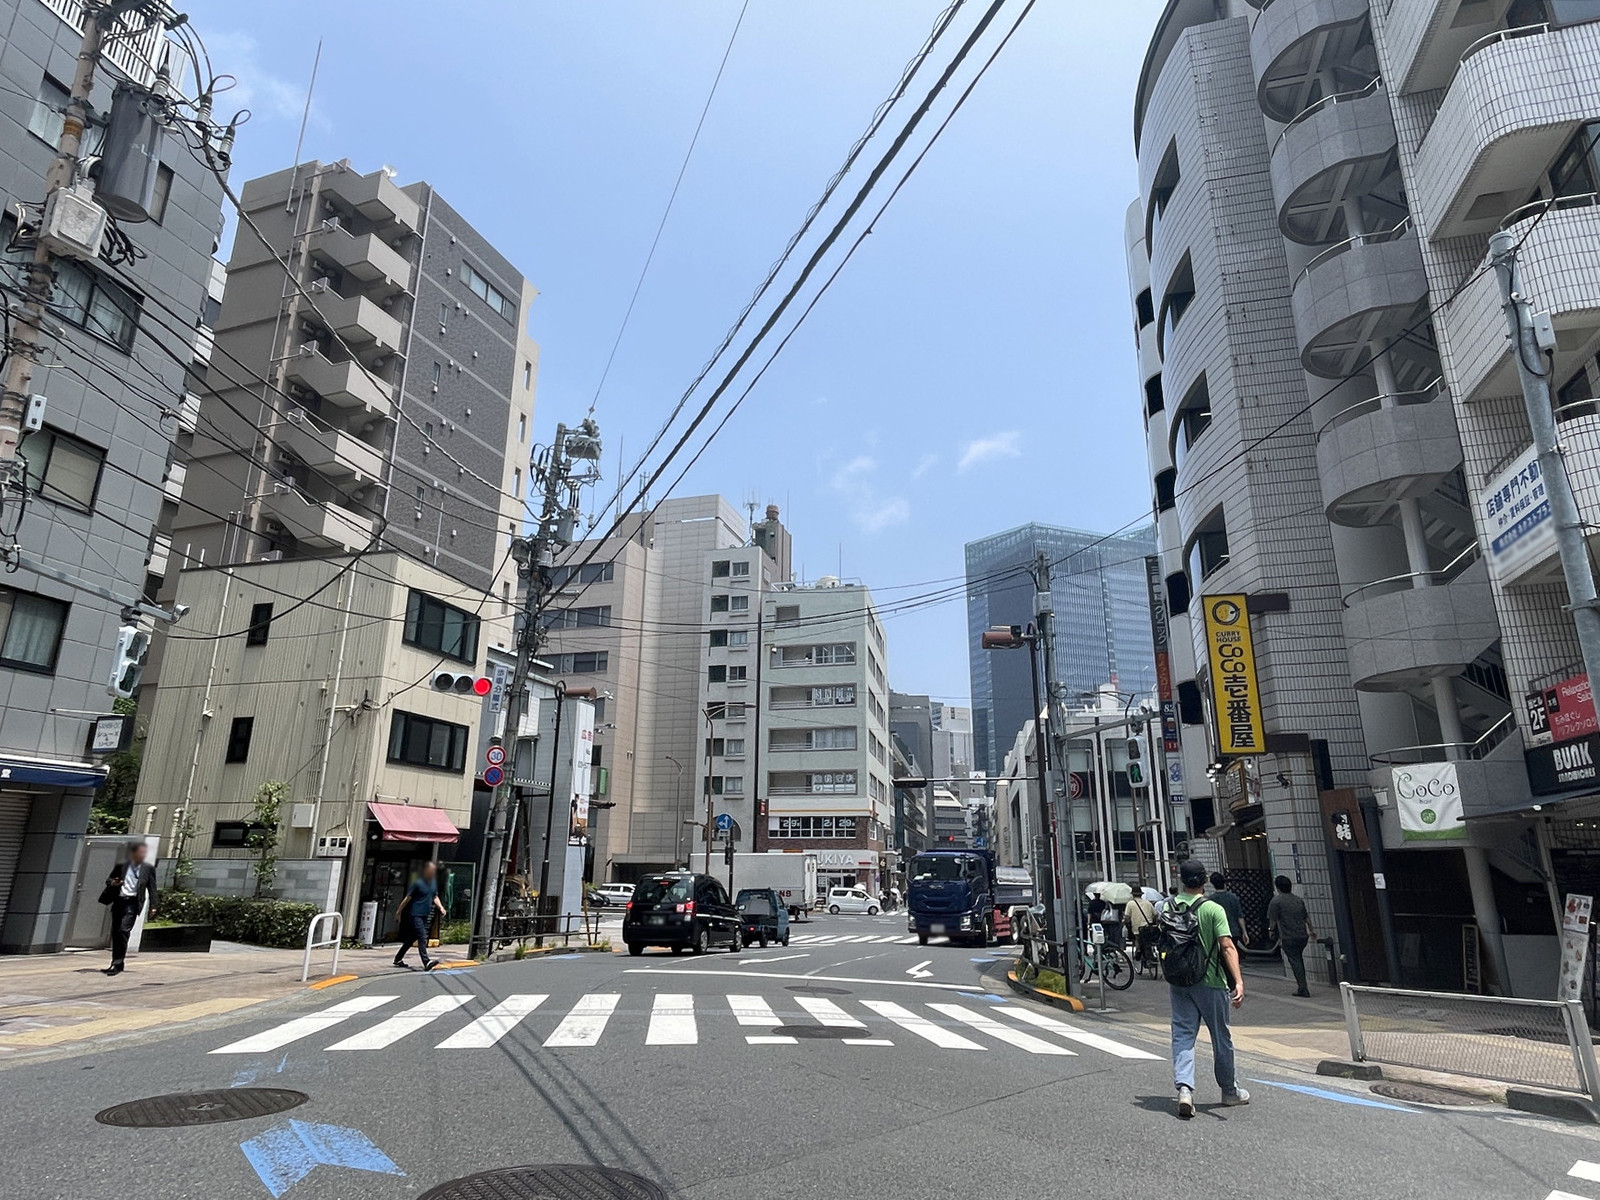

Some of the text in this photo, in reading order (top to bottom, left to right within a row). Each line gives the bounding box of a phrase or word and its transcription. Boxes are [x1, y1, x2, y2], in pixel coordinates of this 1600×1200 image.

[1530, 707, 1546, 731] 2F
[490, 751, 502, 761] 30
[1397, 772, 1455, 800] CoCo
